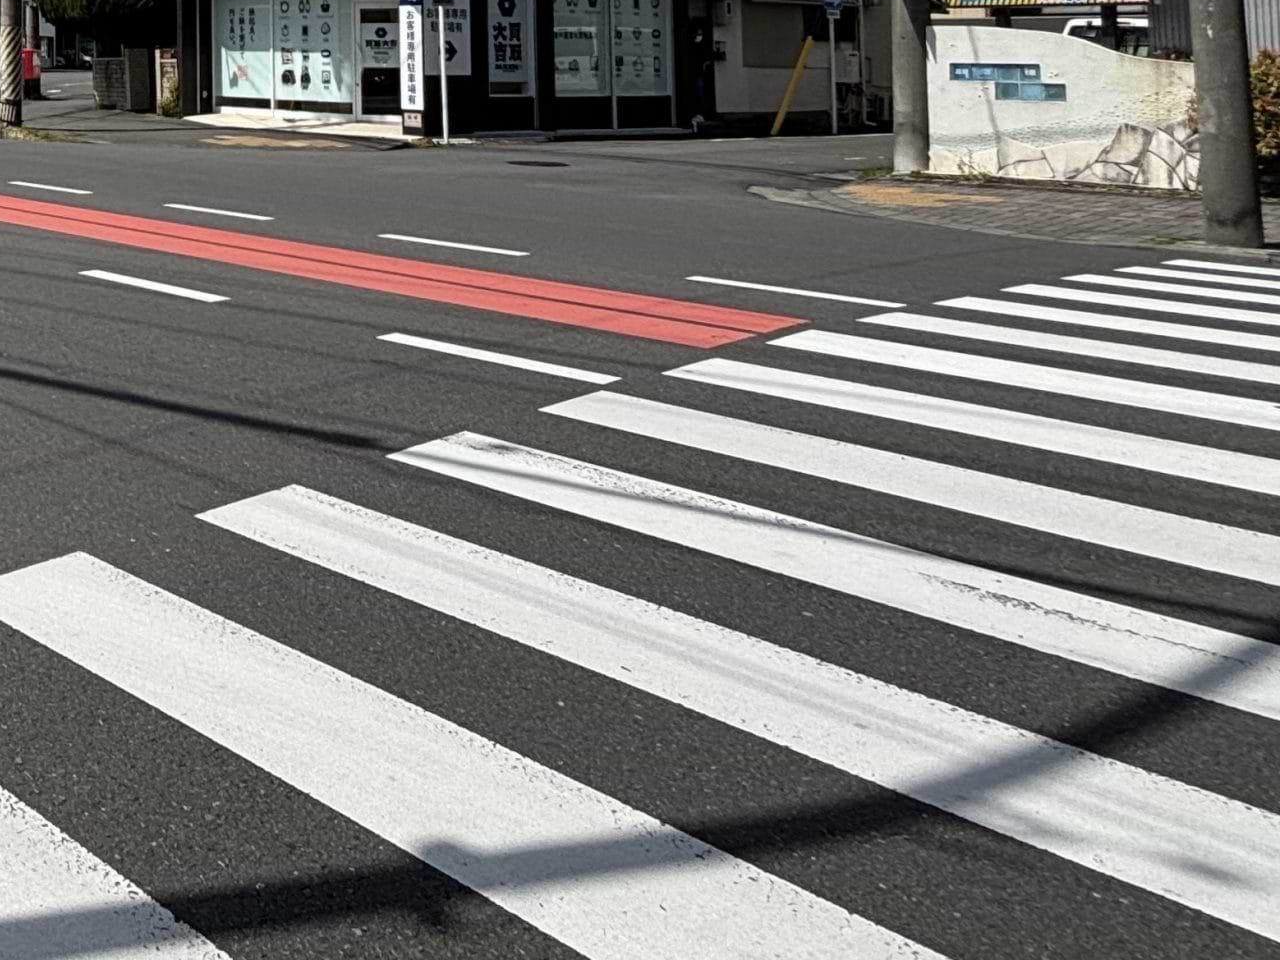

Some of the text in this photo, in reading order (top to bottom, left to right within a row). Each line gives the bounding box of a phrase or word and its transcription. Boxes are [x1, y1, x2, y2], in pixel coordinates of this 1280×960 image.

[431, 21, 463, 33] 駐場有
[406, 10, 417, 105] お客様専用駐車場有
